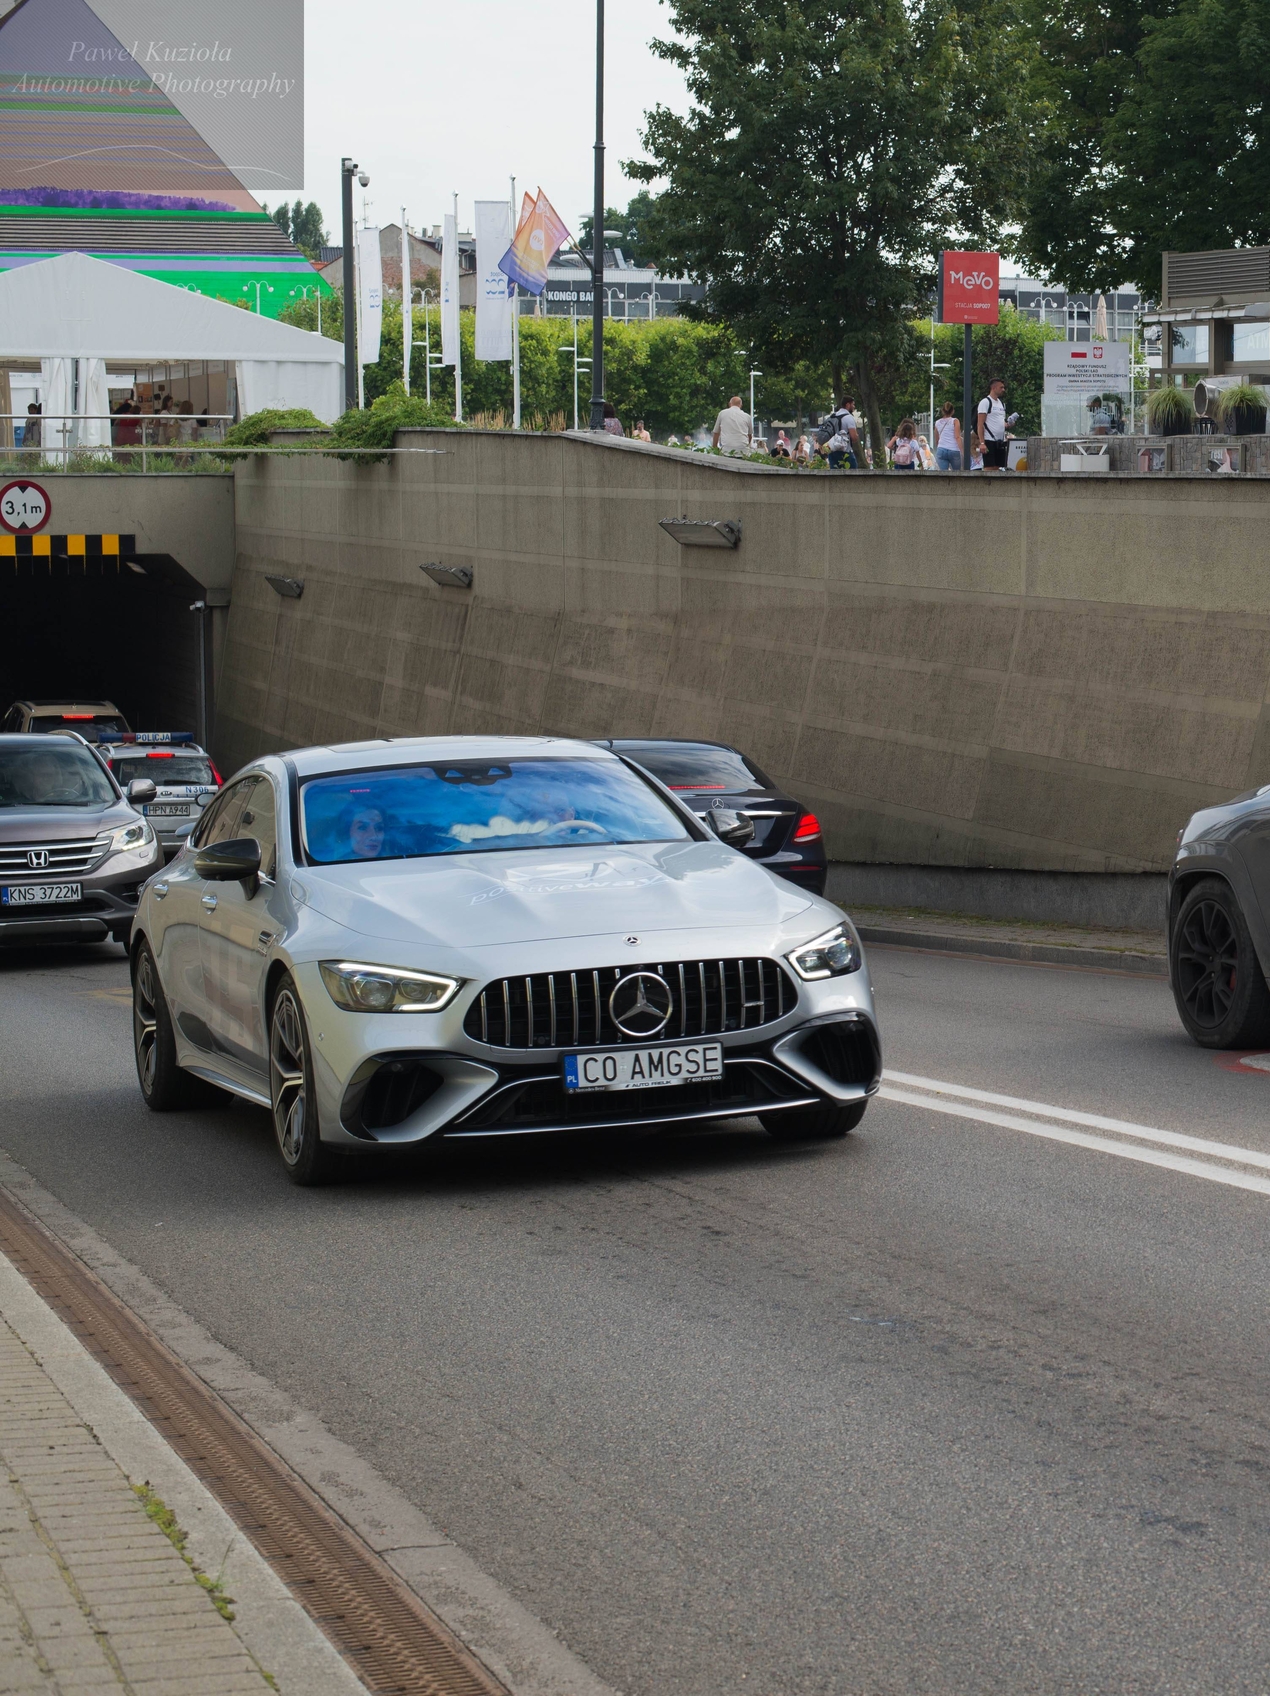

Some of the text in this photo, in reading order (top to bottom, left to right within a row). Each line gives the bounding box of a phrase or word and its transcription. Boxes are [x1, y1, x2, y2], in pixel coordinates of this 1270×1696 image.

[548, 291, 577, 301] KONGO
[136, 733, 171, 742] POLICJA
[149, 806, 189, 814] HPN A944
[9, 885, 79, 901] KNS 3722M
[631, 1046, 719, 1080] AMGSE
[567, 1075, 577, 1083] PL
